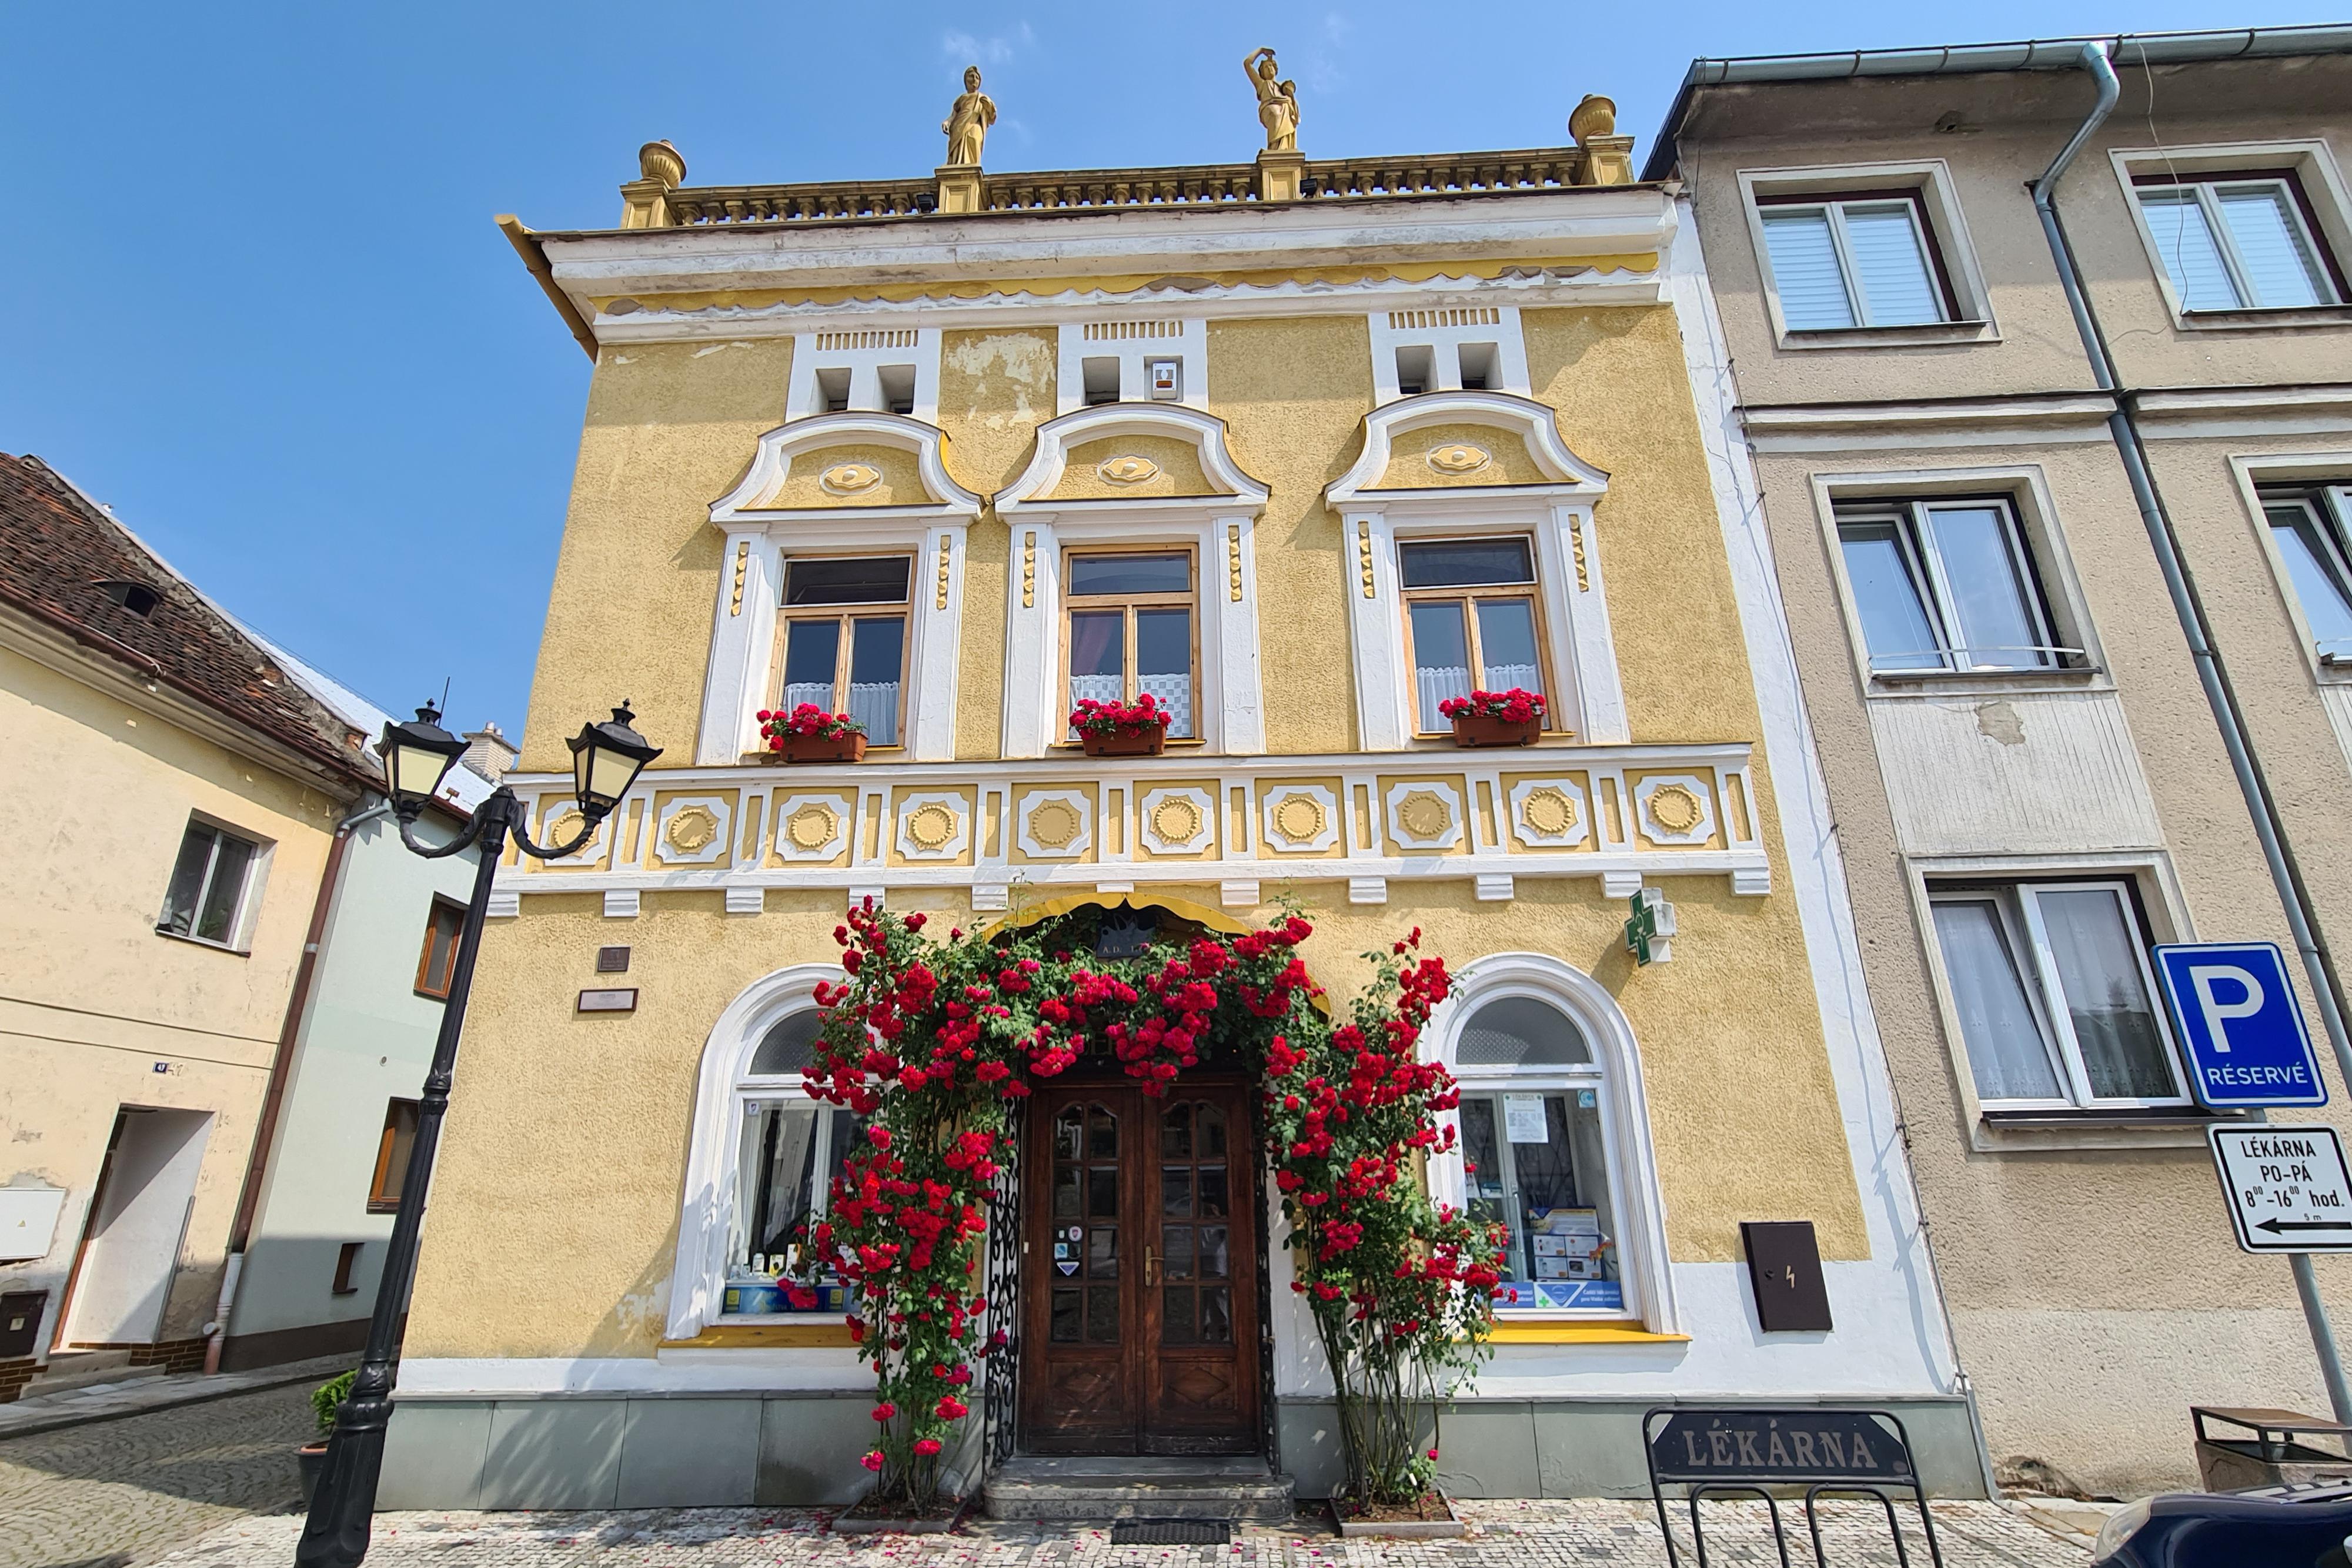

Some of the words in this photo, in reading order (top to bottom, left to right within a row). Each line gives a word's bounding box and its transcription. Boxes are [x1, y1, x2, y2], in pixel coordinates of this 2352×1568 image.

[2189, 965, 2264, 1053] P
[2207, 1062, 2308, 1085] RÉSERVÉ
[2240, 1136, 2317, 1158] LÉKÁRNA
[2260, 1161, 2313, 1182] PO-PÁ
[2308, 1190, 2345, 1207] hod.
[2304, 1213, 2310, 1221] 5
[1682, 1419, 1879, 1469] LÉKÁRNA
